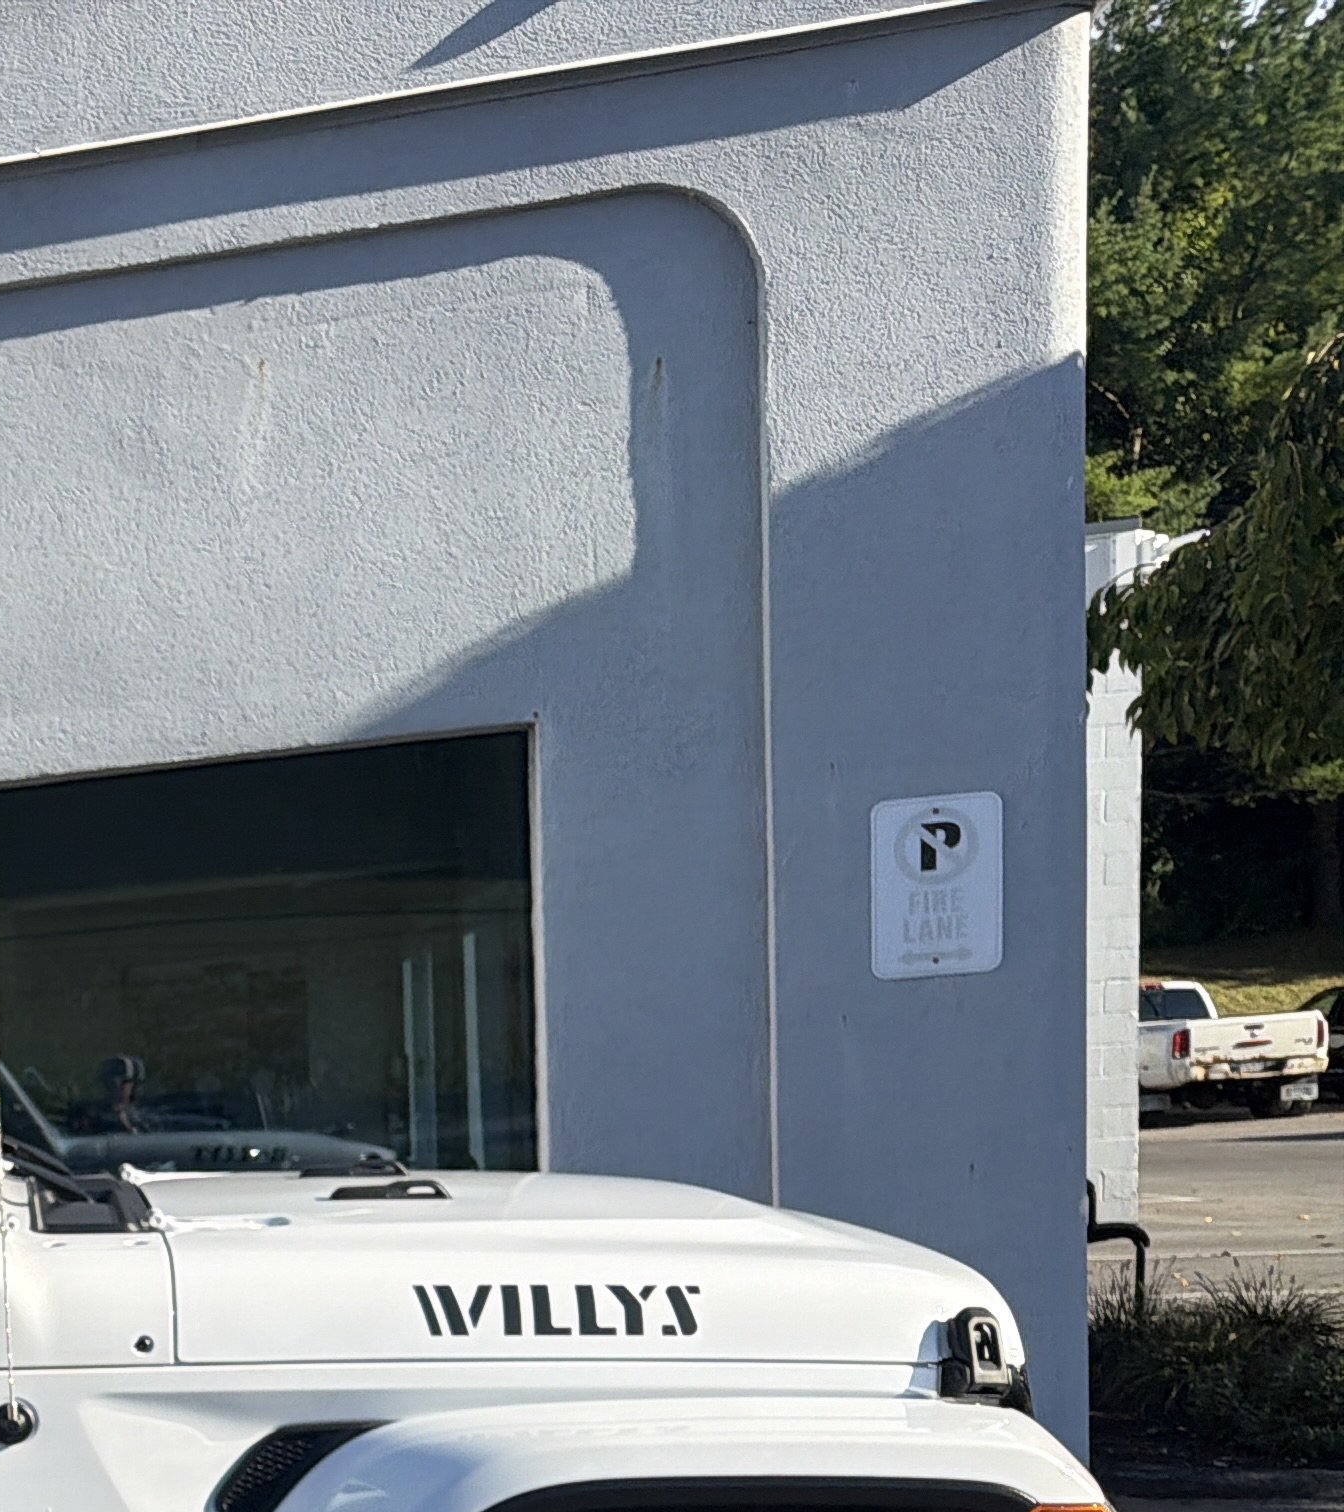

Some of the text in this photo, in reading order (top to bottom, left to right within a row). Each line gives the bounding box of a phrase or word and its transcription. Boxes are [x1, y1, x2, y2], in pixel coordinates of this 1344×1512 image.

[908, 887, 965, 916] FIRE
[903, 914, 969, 944] LANE
[413, 1284, 701, 1337] WILLYS
